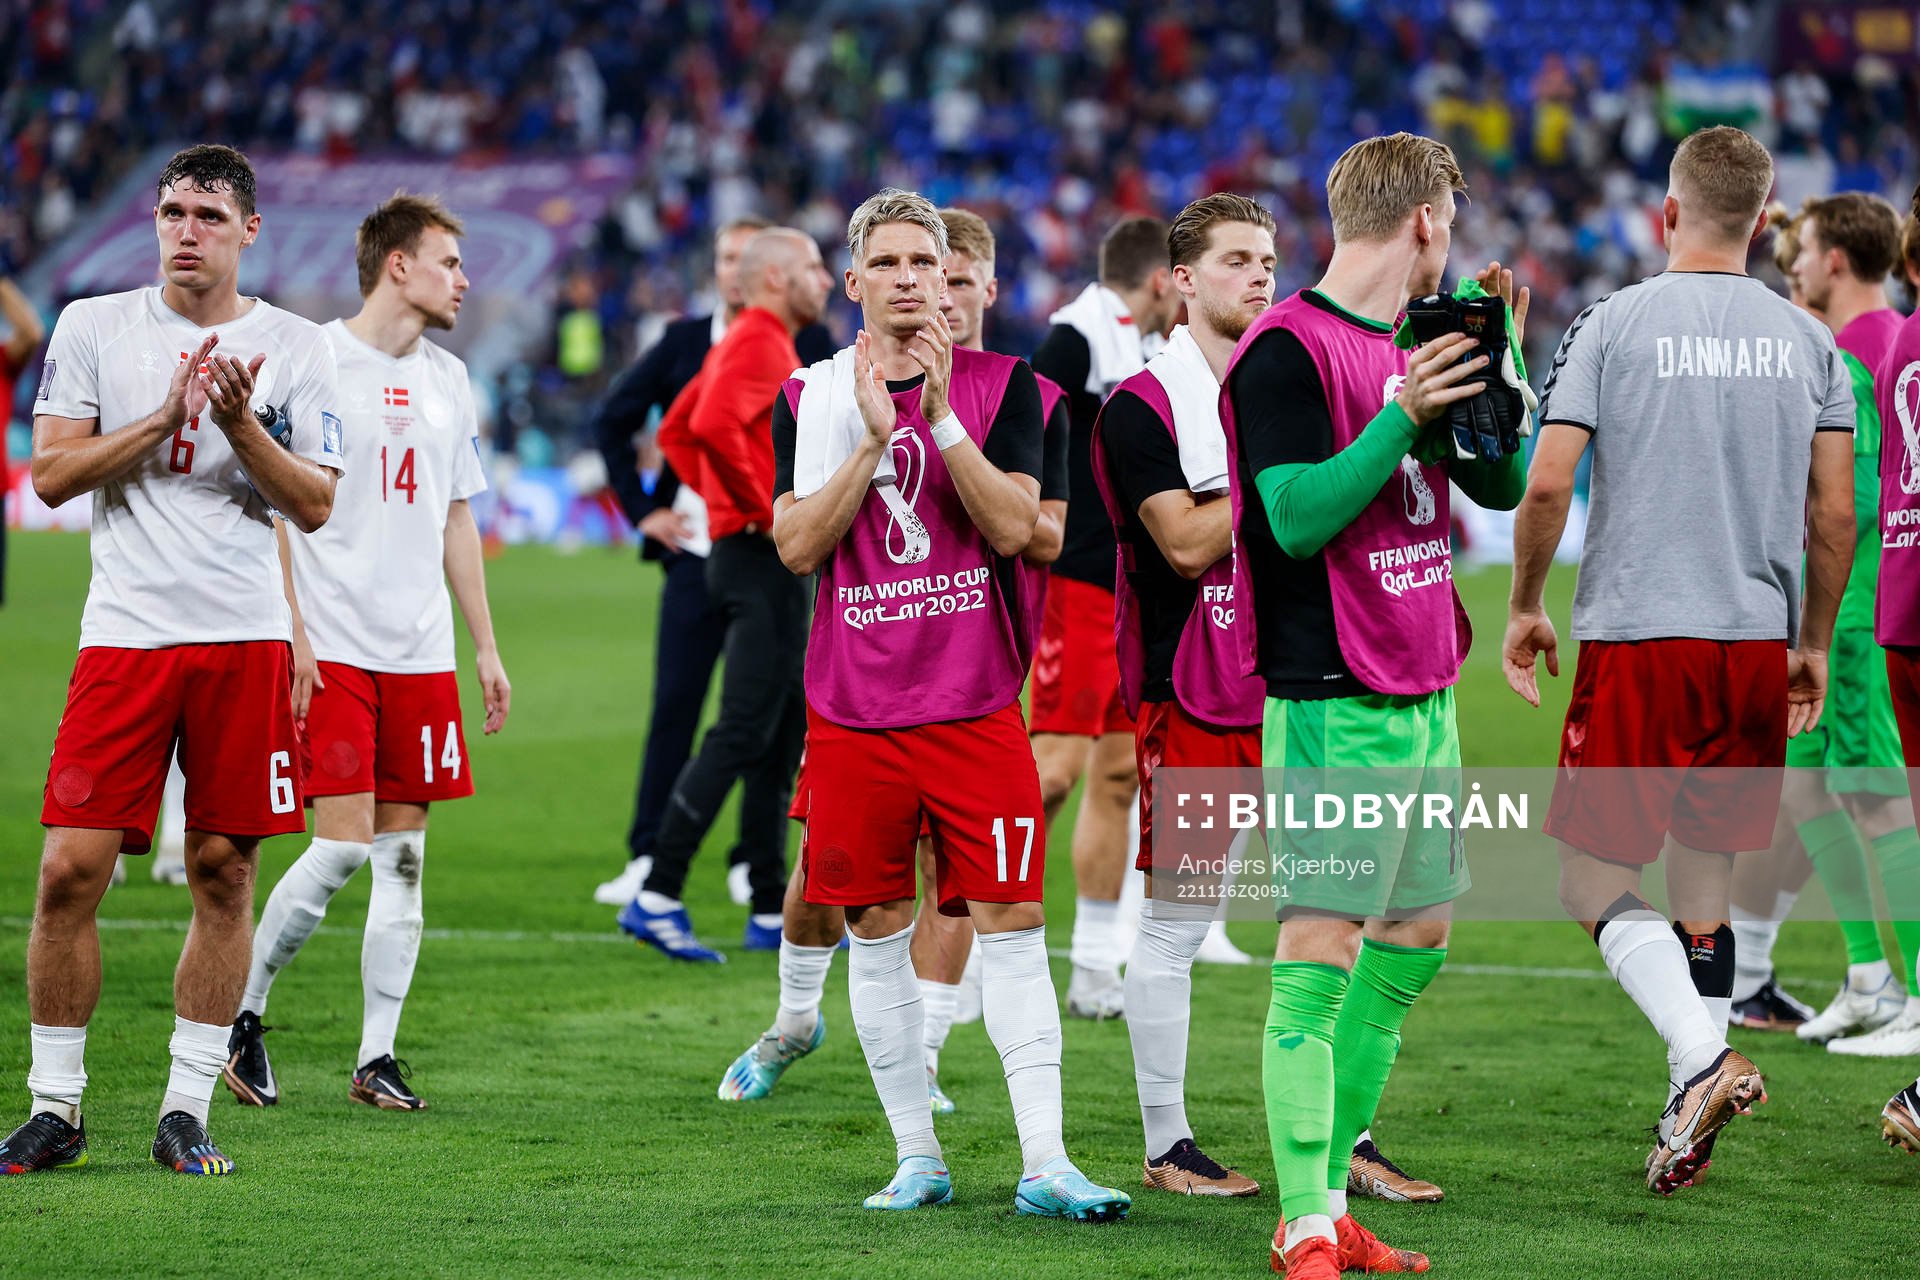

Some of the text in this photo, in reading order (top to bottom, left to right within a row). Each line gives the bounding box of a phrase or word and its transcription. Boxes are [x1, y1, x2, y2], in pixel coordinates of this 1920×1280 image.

[1656, 335, 1794, 379] DANMARK
[169, 416, 201, 474] 6
[380, 446, 418, 504] 14
[1368, 535, 1452, 571] FIFA WORL
[838, 566, 990, 604] FIFA WORLD CUP
[843, 588, 986, 631] Qatar2022
[420, 722, 462, 784] 14
[269, 750, 296, 815] 6
[991, 817, 1035, 882] 17
